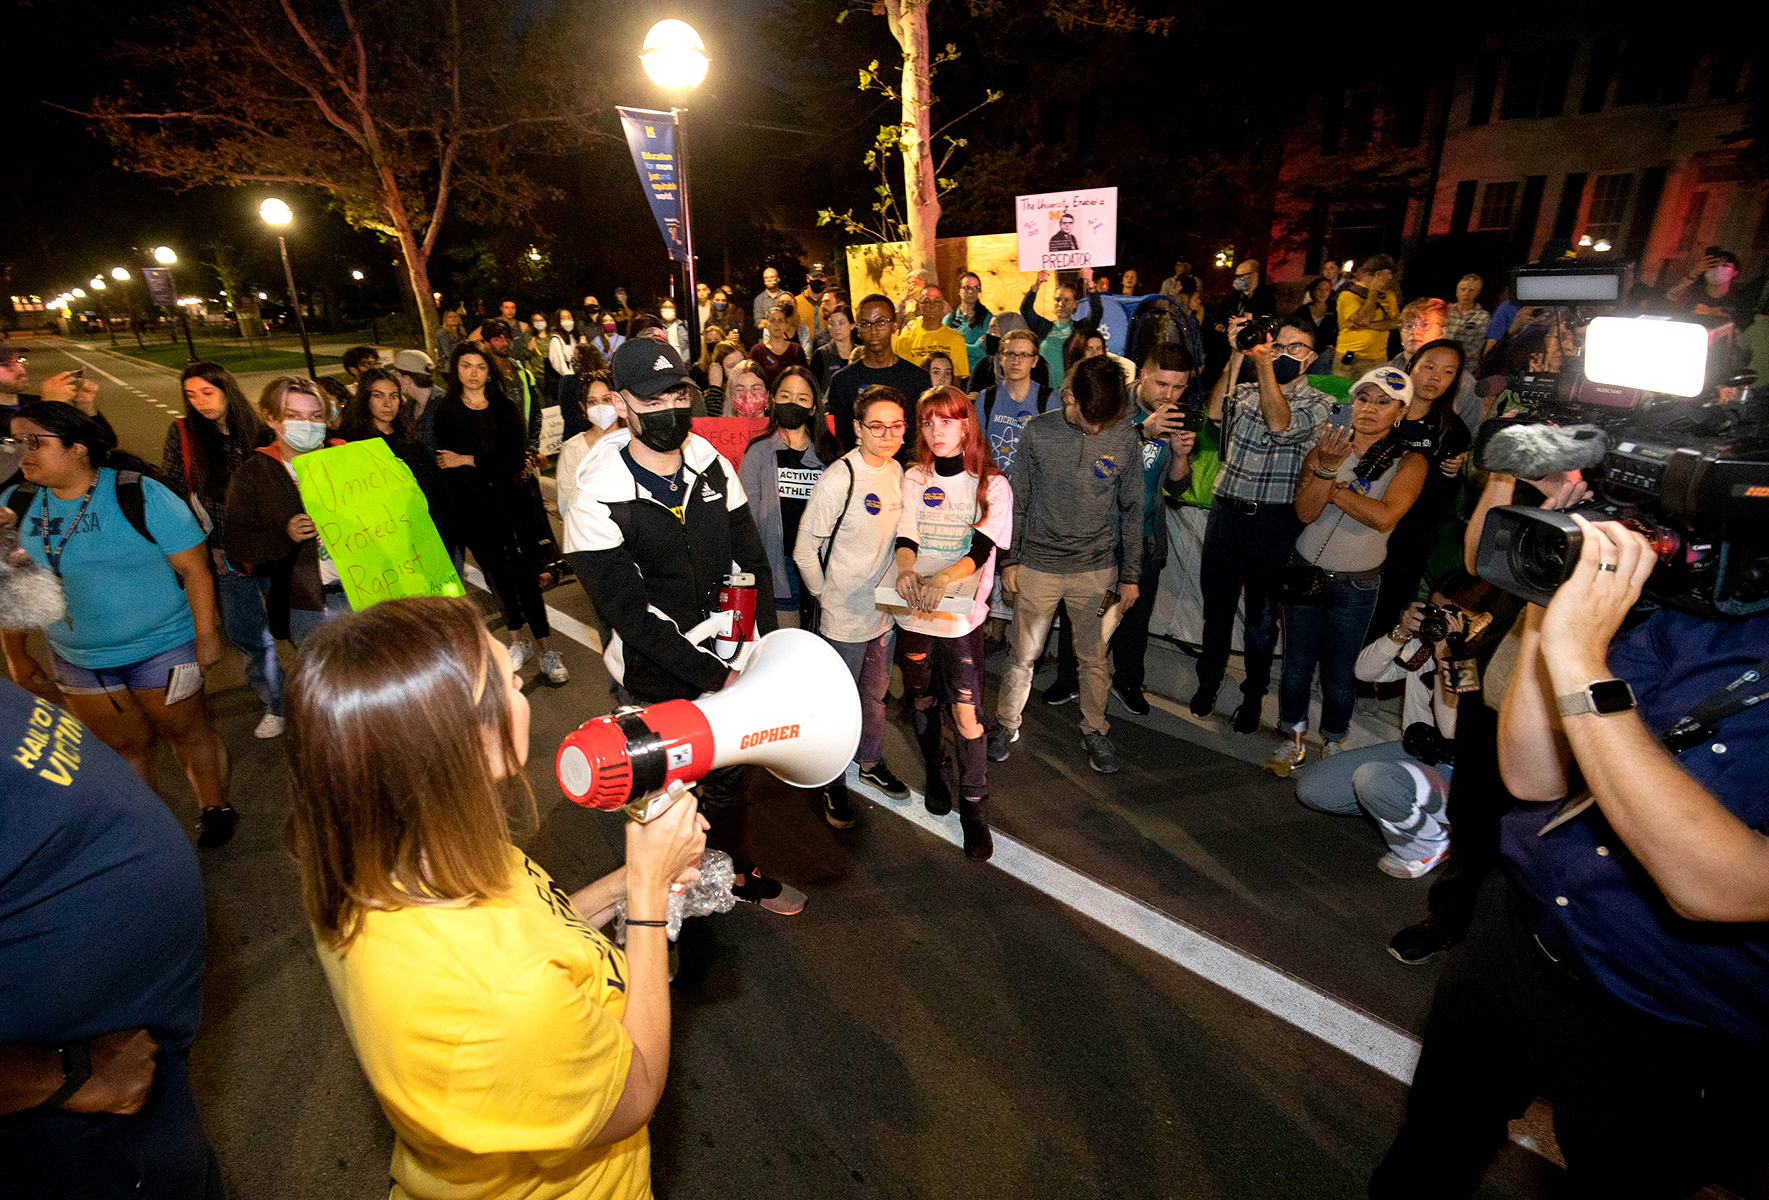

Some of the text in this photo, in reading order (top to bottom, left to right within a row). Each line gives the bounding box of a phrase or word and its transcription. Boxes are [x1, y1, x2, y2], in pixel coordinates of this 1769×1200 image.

[641, 151, 673, 160] Education
[1020, 198, 1035, 211] The
[1042, 252, 1092, 269] PREDATOR
[993, 414, 1026, 429] MICHIG
[306, 455, 405, 513] Umich
[779, 485, 813, 497] ATHLE
[919, 511, 942, 521] THREE
[347, 543, 427, 602] Rapist
[740, 724, 800, 750] GOPHER
[12, 728, 50, 769] HAIL
